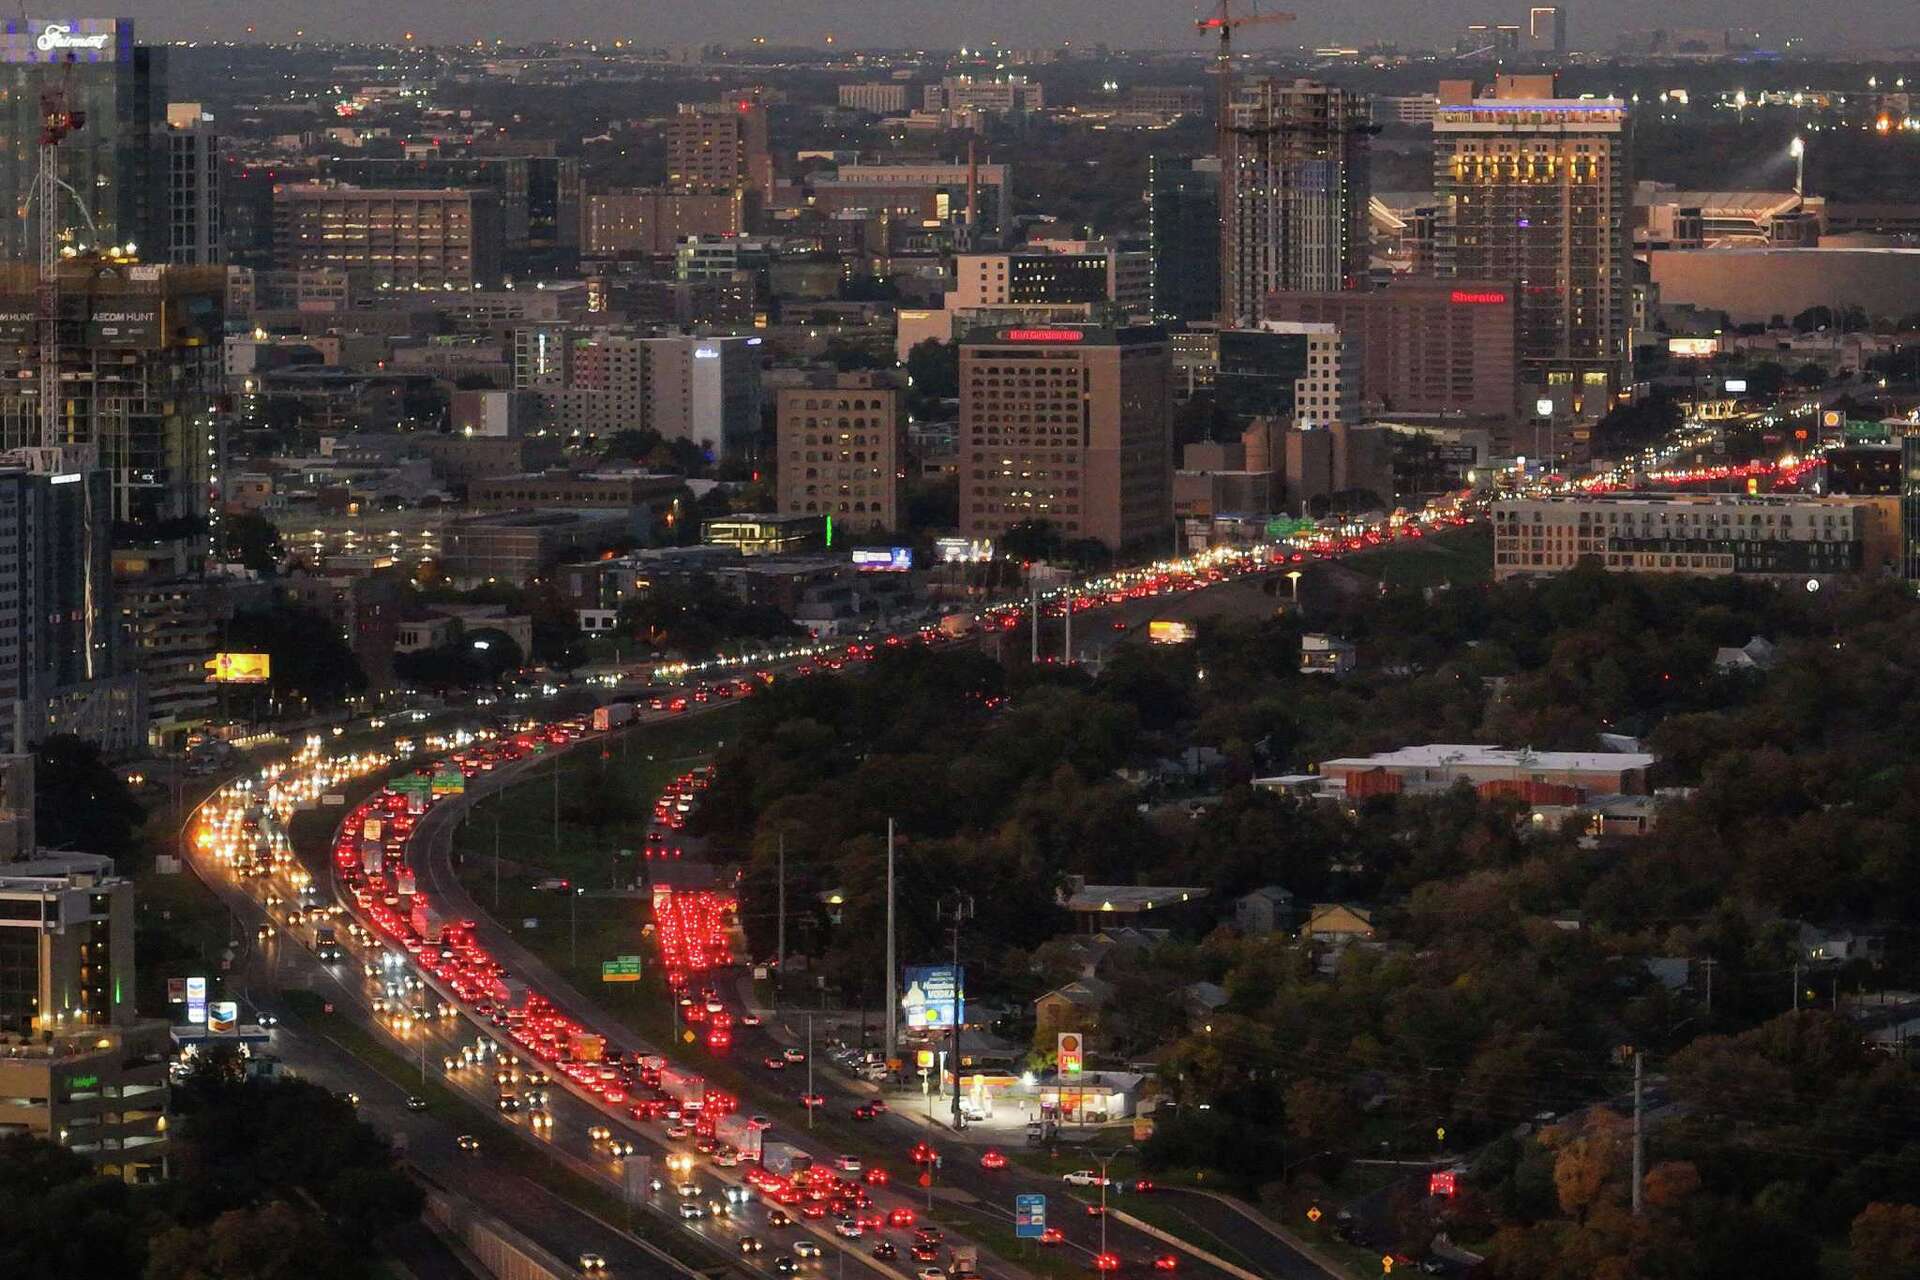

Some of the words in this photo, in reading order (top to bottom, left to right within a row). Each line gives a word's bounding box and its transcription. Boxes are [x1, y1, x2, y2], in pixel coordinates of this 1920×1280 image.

[37, 25, 108, 51] Fairmont
[1451, 291, 1504, 303] Sheraton
[92, 312, 125, 321] AECOM
[126, 312, 154, 321] HUNT
[928, 990, 955, 999] VODKA
